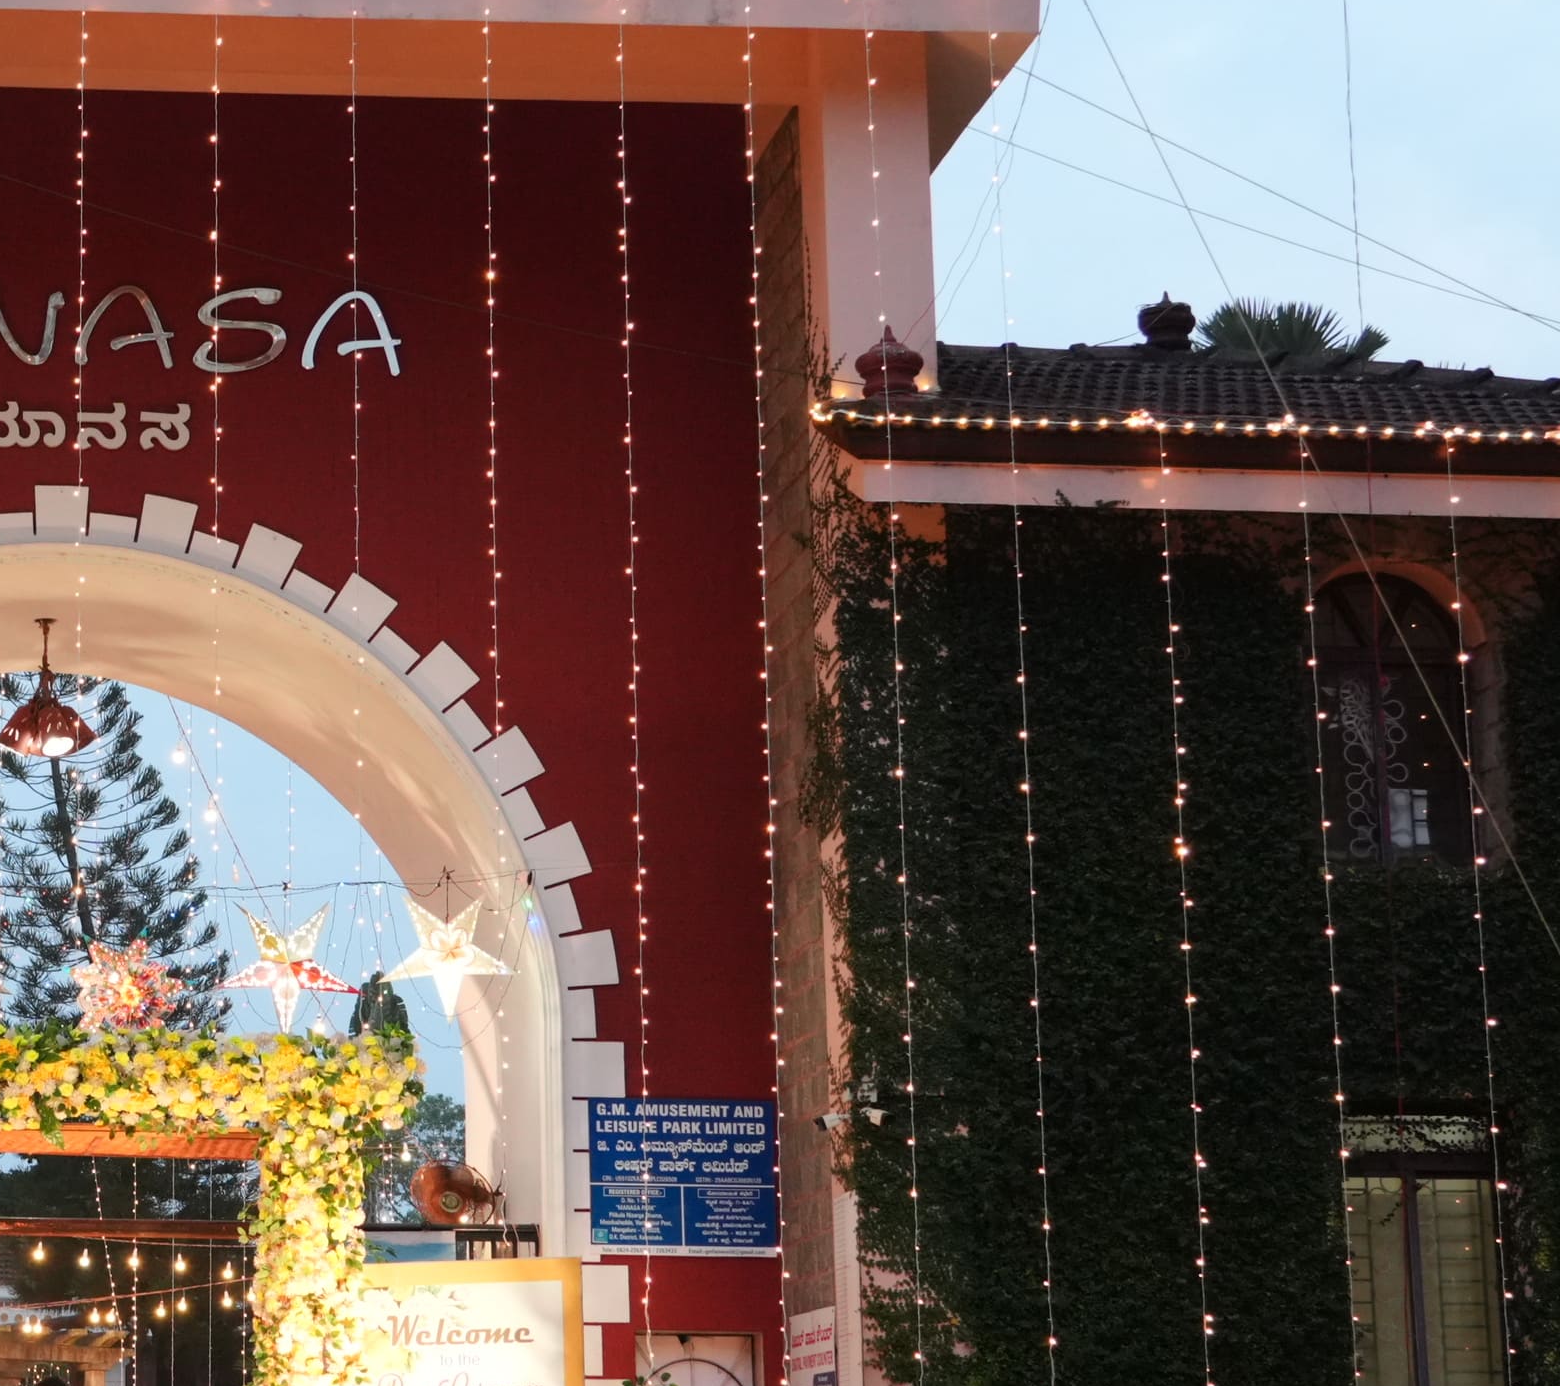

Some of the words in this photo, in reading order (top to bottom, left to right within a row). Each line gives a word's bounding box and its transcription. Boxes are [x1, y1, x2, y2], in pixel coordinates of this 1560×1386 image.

[596, 1103, 630, 1116] G.M.
[635, 1103, 729, 1118] AMUSEMENT
[733, 1105, 764, 1118] AND
[596, 1120, 657, 1133] LEISURE
[662, 1121, 701, 1134] PARK
[705, 1122, 766, 1135] LIMITED
[387, 1314, 535, 1346] Welcome
[440, 1354, 453, 1366] to
[457, 1353, 480, 1366] the
